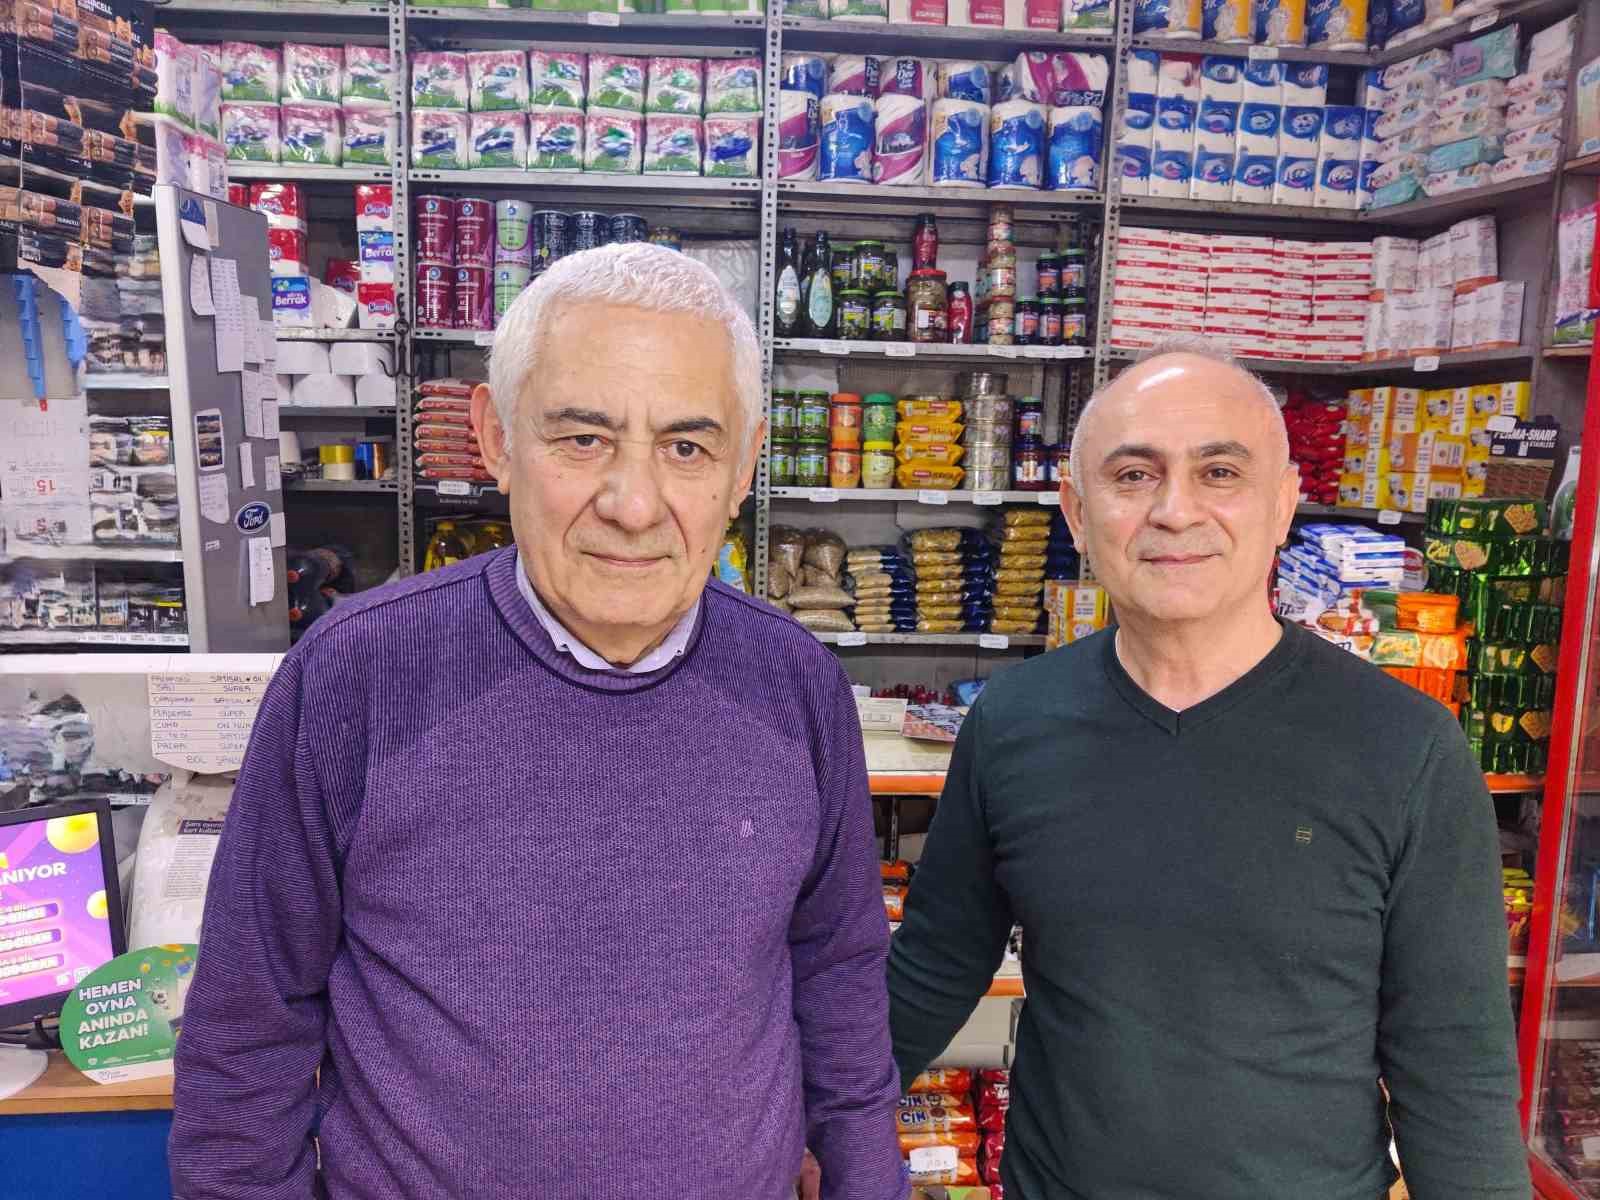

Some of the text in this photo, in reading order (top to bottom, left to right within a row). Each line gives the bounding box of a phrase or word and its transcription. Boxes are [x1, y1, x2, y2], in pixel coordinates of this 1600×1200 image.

[366, 248, 393, 258] Berra
[275, 295, 307, 306] Berrak
[243, 508, 264, 528] Ford
[79, 978, 142, 1001] HEMEN
[85, 995, 137, 1015] OYNA
[78, 1007, 149, 1034] ANINDA
[79, 1023, 149, 1050] KAZAN!
